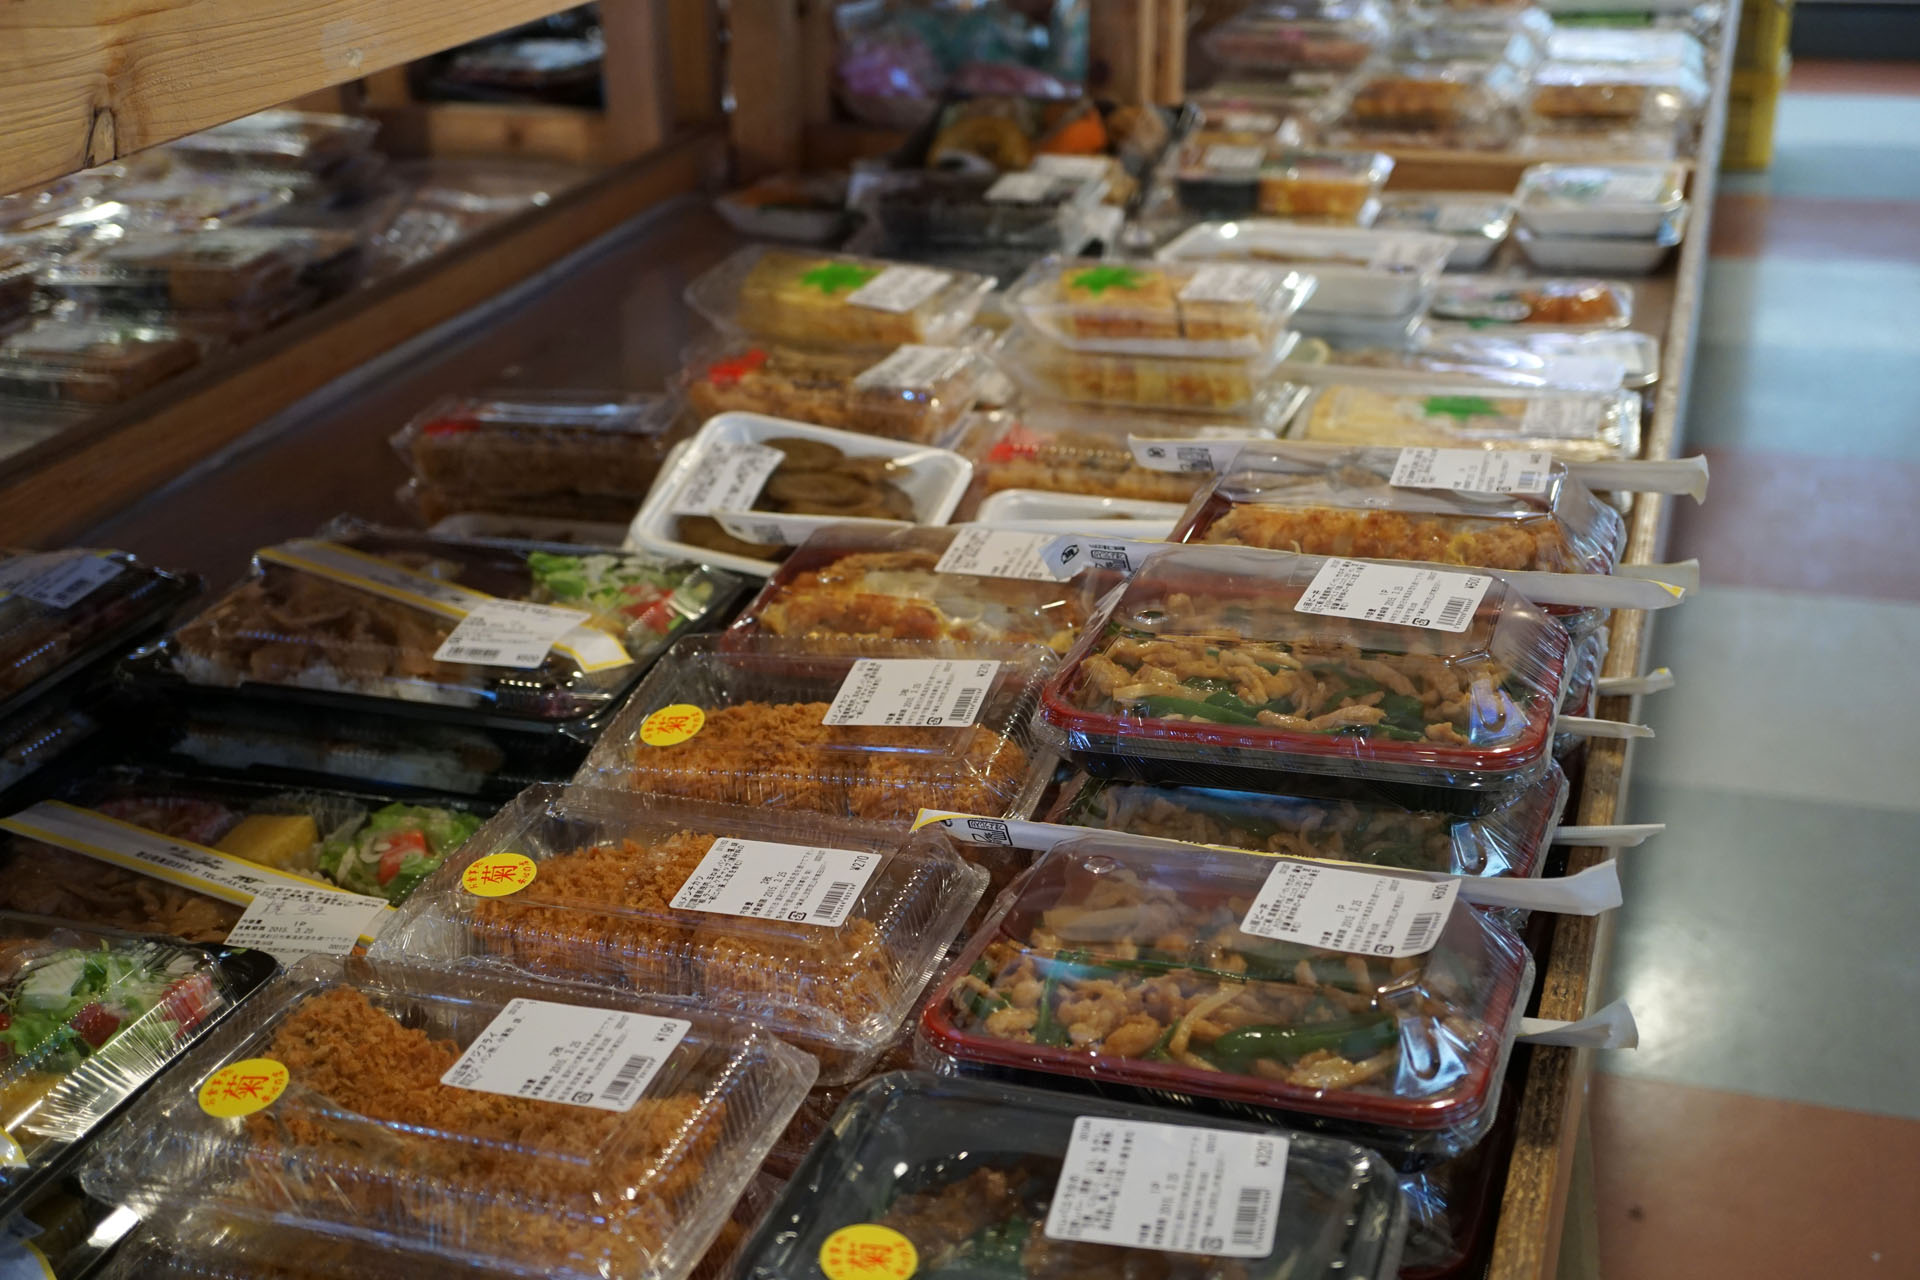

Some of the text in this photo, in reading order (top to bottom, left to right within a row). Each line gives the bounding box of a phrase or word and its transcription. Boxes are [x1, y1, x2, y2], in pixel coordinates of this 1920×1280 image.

[848, 854, 870, 871] ¥270
[480, 864, 518, 885] 菊
[651, 1021, 679, 1042] ¥190
[223, 1073, 270, 1101] 菊
